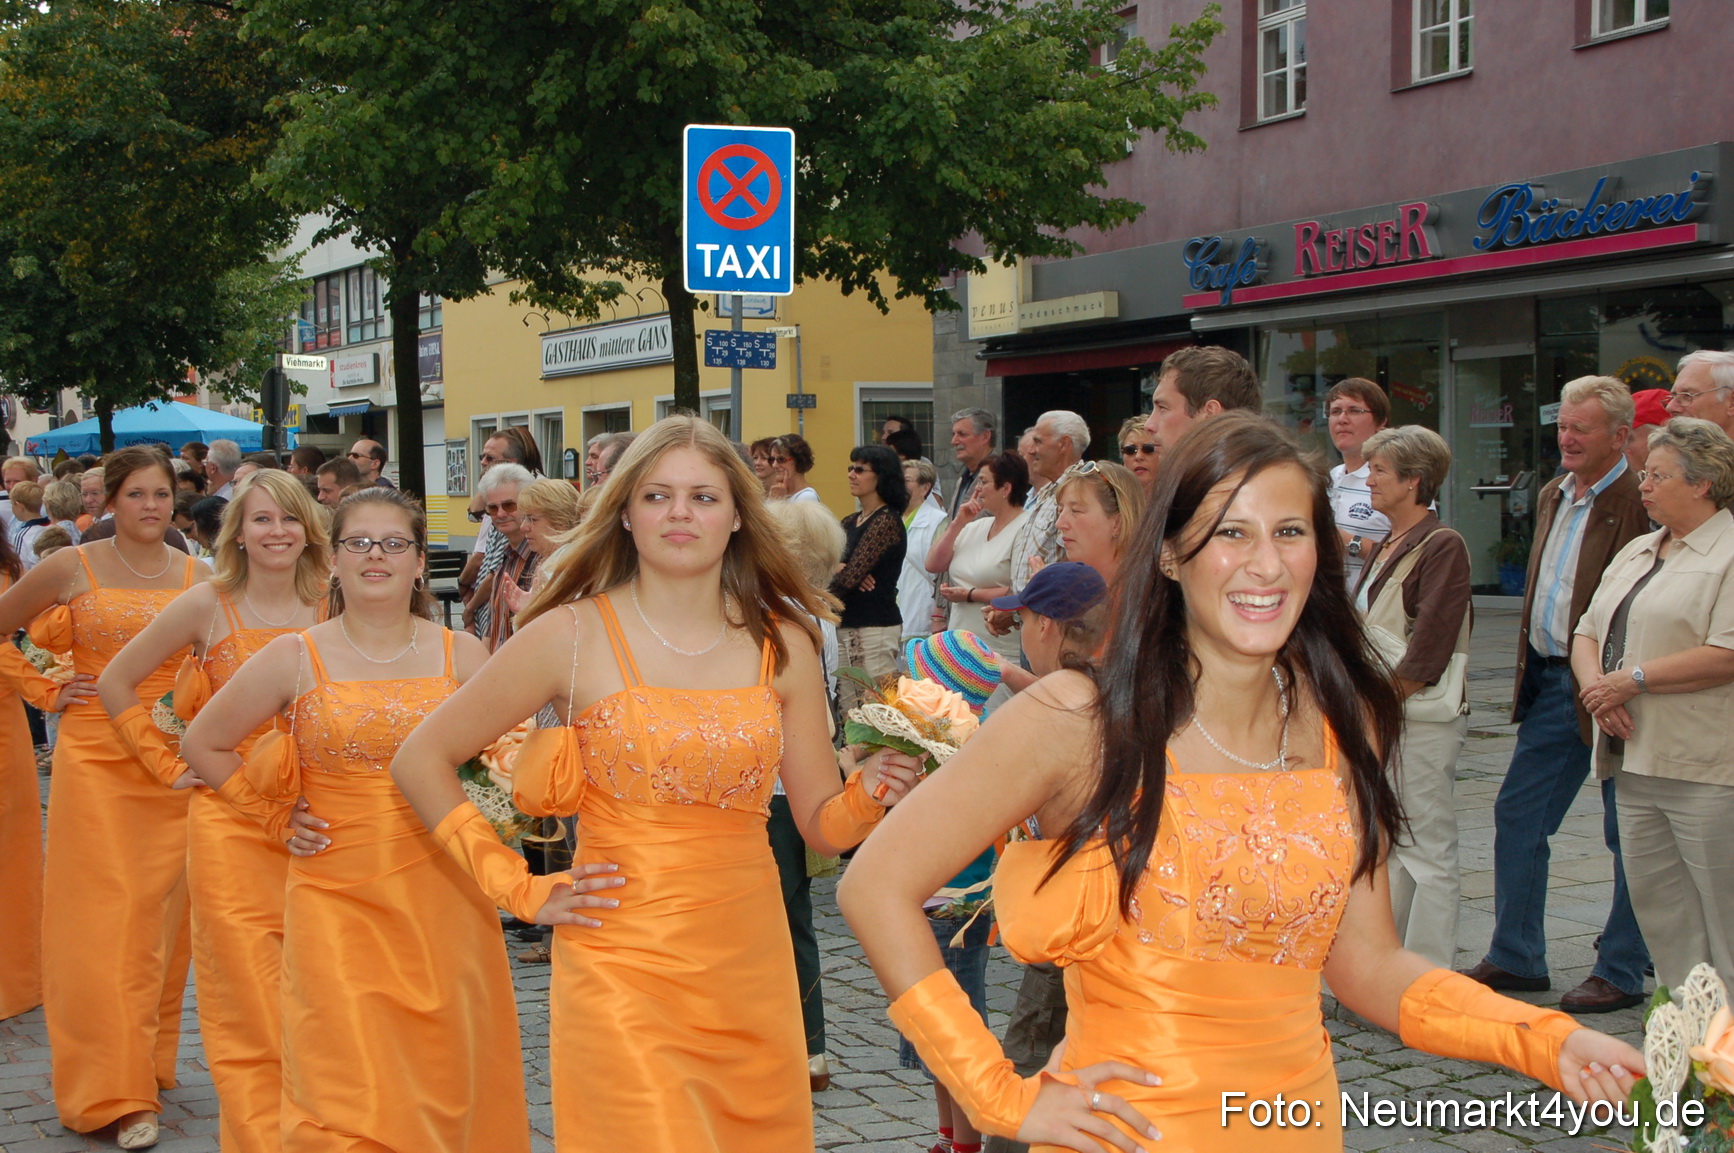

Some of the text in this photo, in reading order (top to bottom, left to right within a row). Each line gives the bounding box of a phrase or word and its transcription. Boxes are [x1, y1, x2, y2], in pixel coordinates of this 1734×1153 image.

[1183, 170, 1701, 306] Café REISER Bäckerei
[696, 243, 781, 279] TAXI
[972, 301, 1014, 318] venus
[1021, 301, 1103, 320] modeschmuck
[545, 324, 669, 366] GASTHAUS mittlere GANS
[707, 337, 712, 346] S
[731, 338, 736, 347] S
[754, 339, 759, 348] S
[286, 356, 325, 369] Viehmarkt
